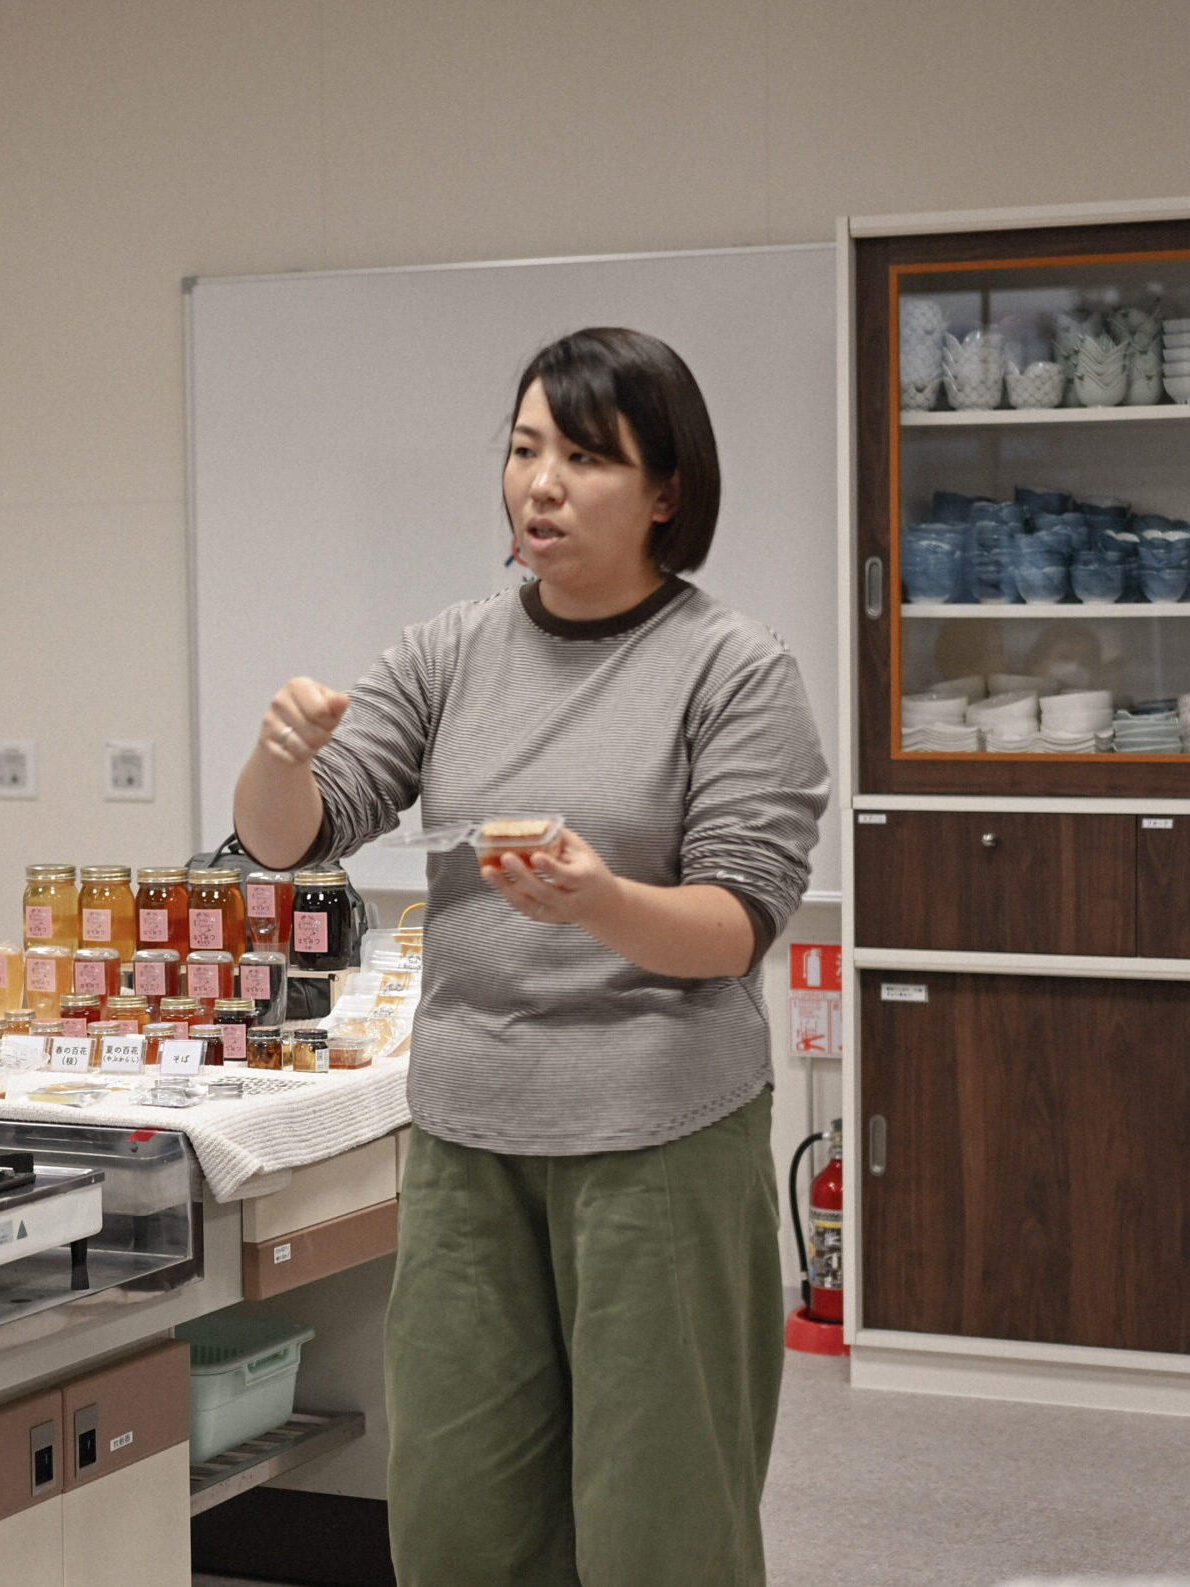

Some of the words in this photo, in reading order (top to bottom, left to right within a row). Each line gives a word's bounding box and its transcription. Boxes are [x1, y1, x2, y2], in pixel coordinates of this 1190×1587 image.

[56, 1046, 88, 1055] 春の百花
[105, 1045, 139, 1055] 夏の百花
[172, 1055, 190, 1064] そば
